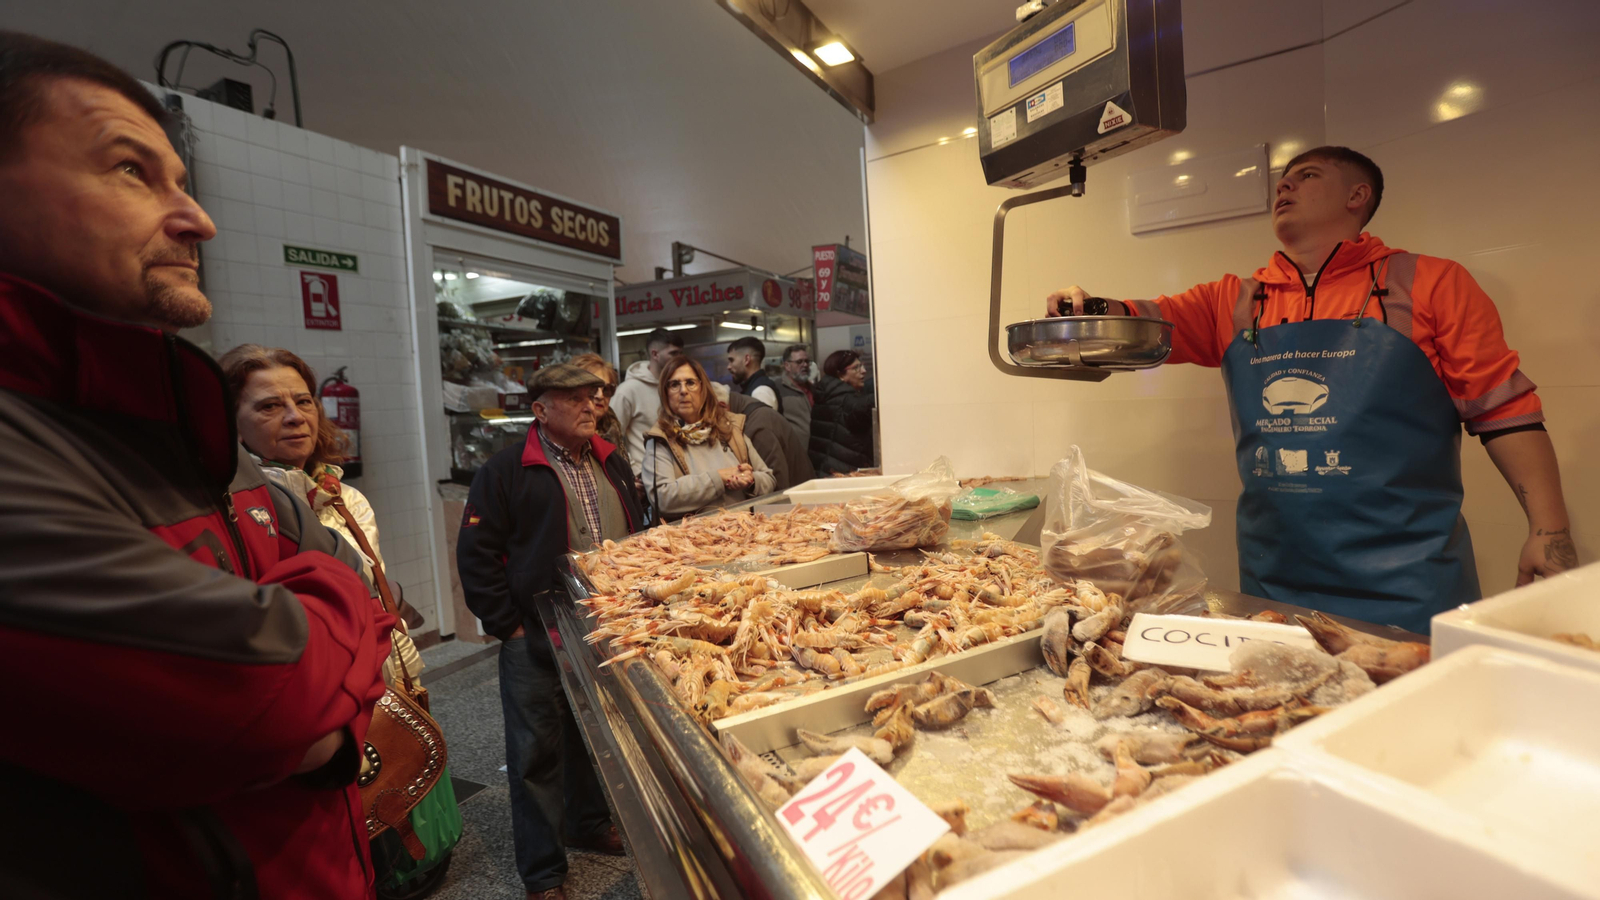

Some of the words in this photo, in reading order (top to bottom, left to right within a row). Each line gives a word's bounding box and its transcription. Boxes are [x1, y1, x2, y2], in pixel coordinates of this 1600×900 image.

[447, 174, 543, 229] FRUTOS
[551, 206, 610, 247] SECOS
[287, 248, 341, 267] SALIDA
[814, 250, 835, 260] PUESTO
[818, 267, 831, 278] 69
[669, 281, 745, 307] Vilches
[788, 287, 803, 309] 98
[818, 292, 830, 302] 70
[306, 318, 339, 327] EXTINTOR
[1250, 357, 1262, 365] Una
[1262, 353, 1281, 363] manera
[1282, 351, 1294, 359] de
[1294, 350, 1320, 359] hacer
[1321, 349, 1356, 360] Europa
[1263, 369, 1282, 385] CALIDAD
[1287, 368, 1326, 382] CONFIANZA
[1140, 626, 1286, 649] COCI
